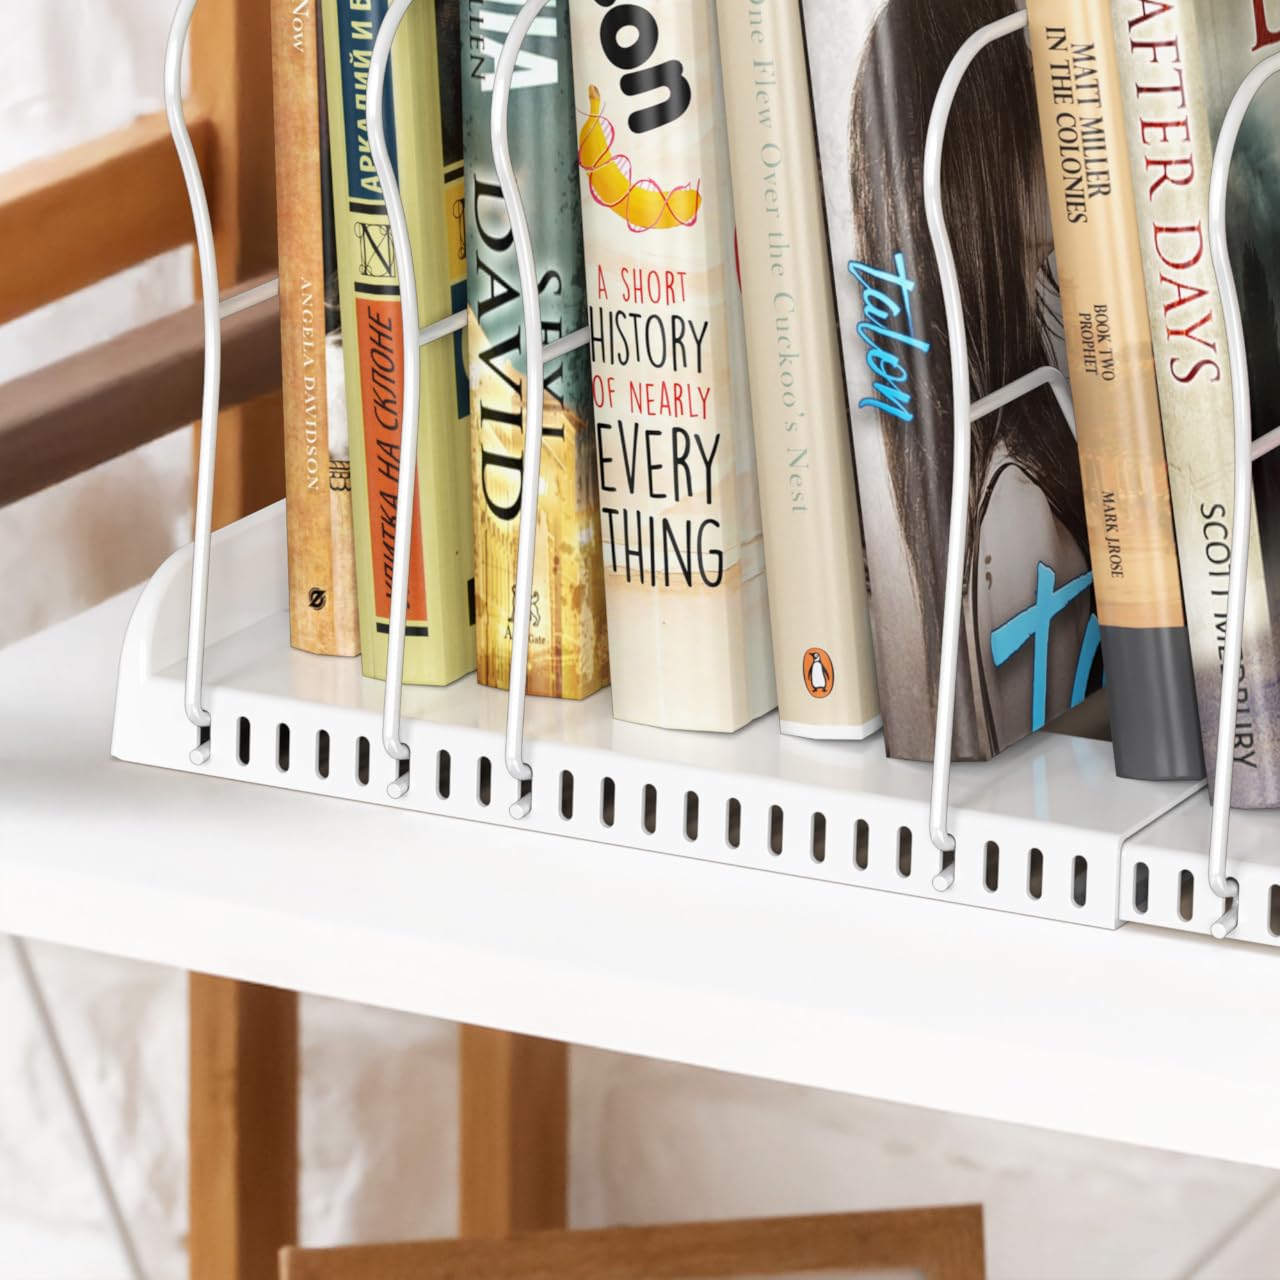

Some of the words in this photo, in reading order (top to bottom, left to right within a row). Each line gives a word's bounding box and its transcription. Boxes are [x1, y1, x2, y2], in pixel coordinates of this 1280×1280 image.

[351, 21, 374, 39] И
[1045, 25, 1067, 51] IN
[754, 59, 777, 128] Flew
[1050, 58, 1073, 105] THE
[1070, 42, 1101, 110] MATT
[761, 143, 782, 217] Over
[1055, 113, 1088, 225] COLONIES
[1080, 116, 1111, 198] MILLER
[598, 264, 608, 300] A
[621, 267, 687, 305] SHORT
[767, 228, 785, 277] the
[301, 277, 315, 366] ANGELA
[1093, 304, 1109, 343] BOOK
[1153, 219, 1220, 384] DAYS
[368, 306, 398, 431] СКЛОНЕ
[474, 173, 524, 521] DAVID
[589, 305, 708, 373] HISTORY
[848, 252, 931, 422] talon
[1078, 312, 1098, 376] PROPHET
[1098, 349, 1115, 381] TWO
[592, 374, 615, 408] OF
[629, 380, 710, 419] NEARLY
[303, 376, 319, 490] DAVIDSON
[376, 439, 400, 484] НА
[597, 419, 720, 504] EVERY
[787, 447, 809, 514] Nest
[1102, 491, 1118, 535] MARK
[602, 507, 723, 588] THING
